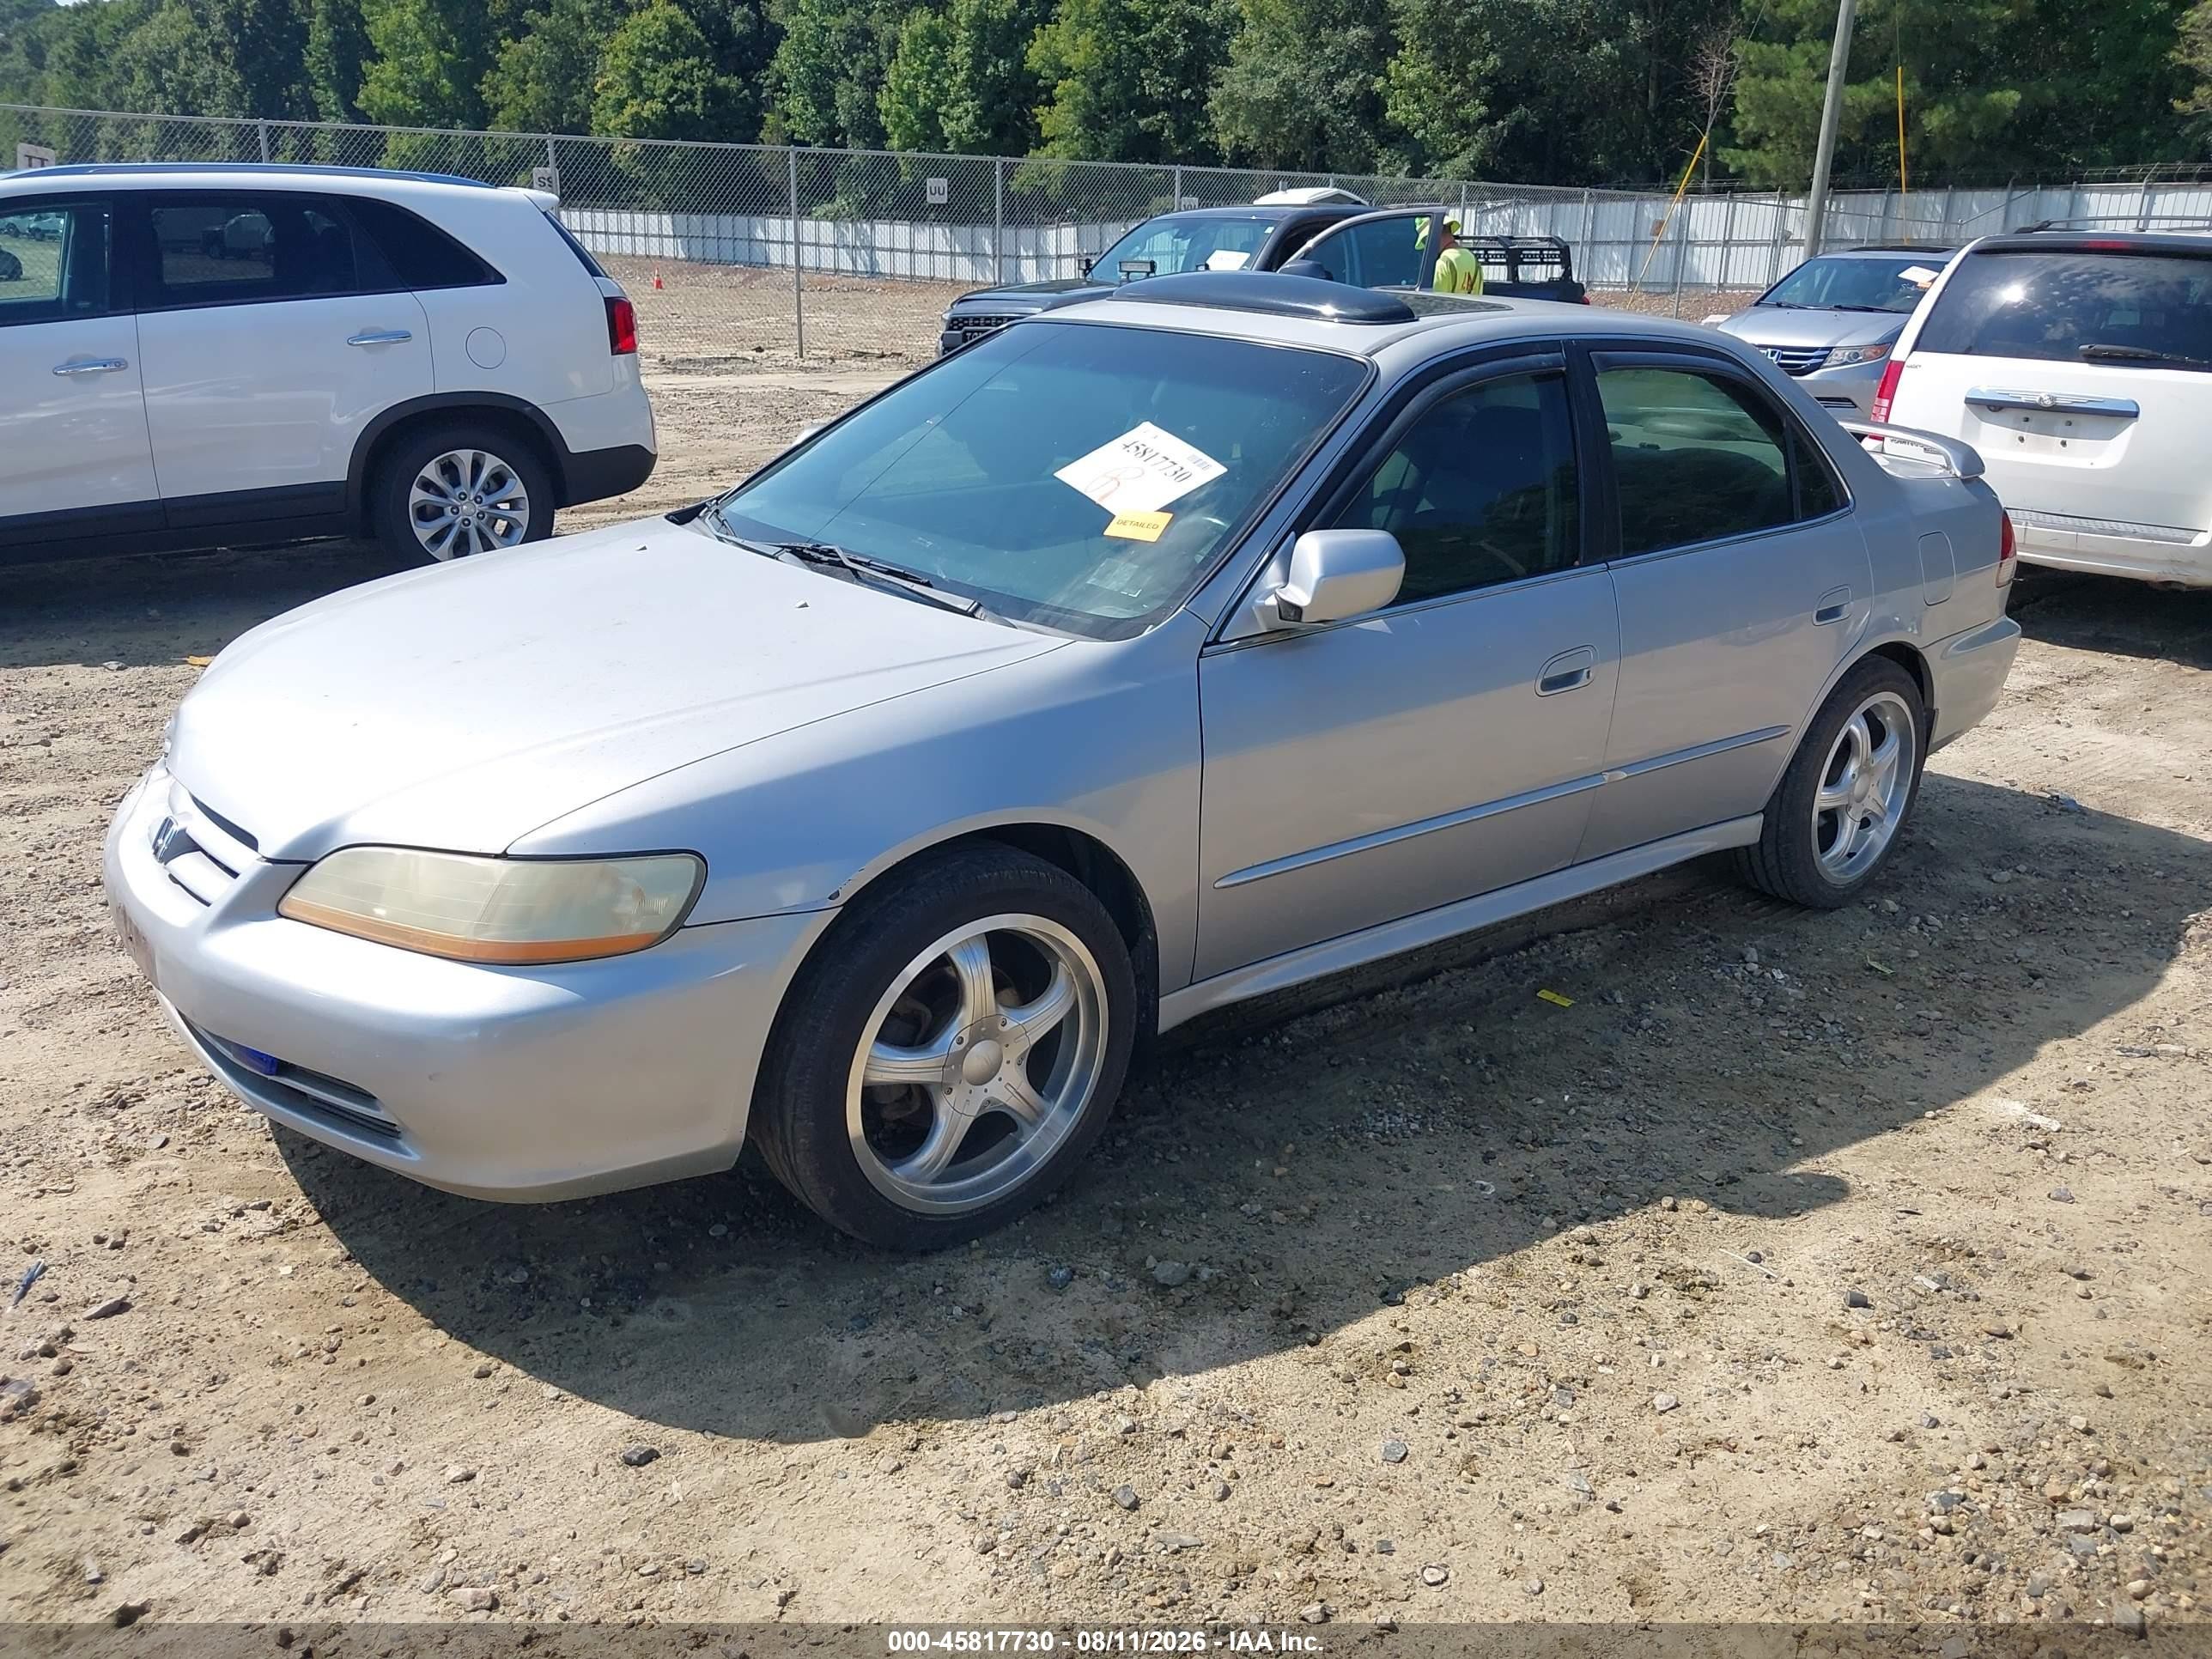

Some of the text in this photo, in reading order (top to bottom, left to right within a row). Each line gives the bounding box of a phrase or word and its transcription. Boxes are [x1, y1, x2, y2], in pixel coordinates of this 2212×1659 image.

[929, 185, 945, 196] UU
[1121, 440, 1193, 483] 45817730
[1116, 519, 1159, 530] DETAILED
